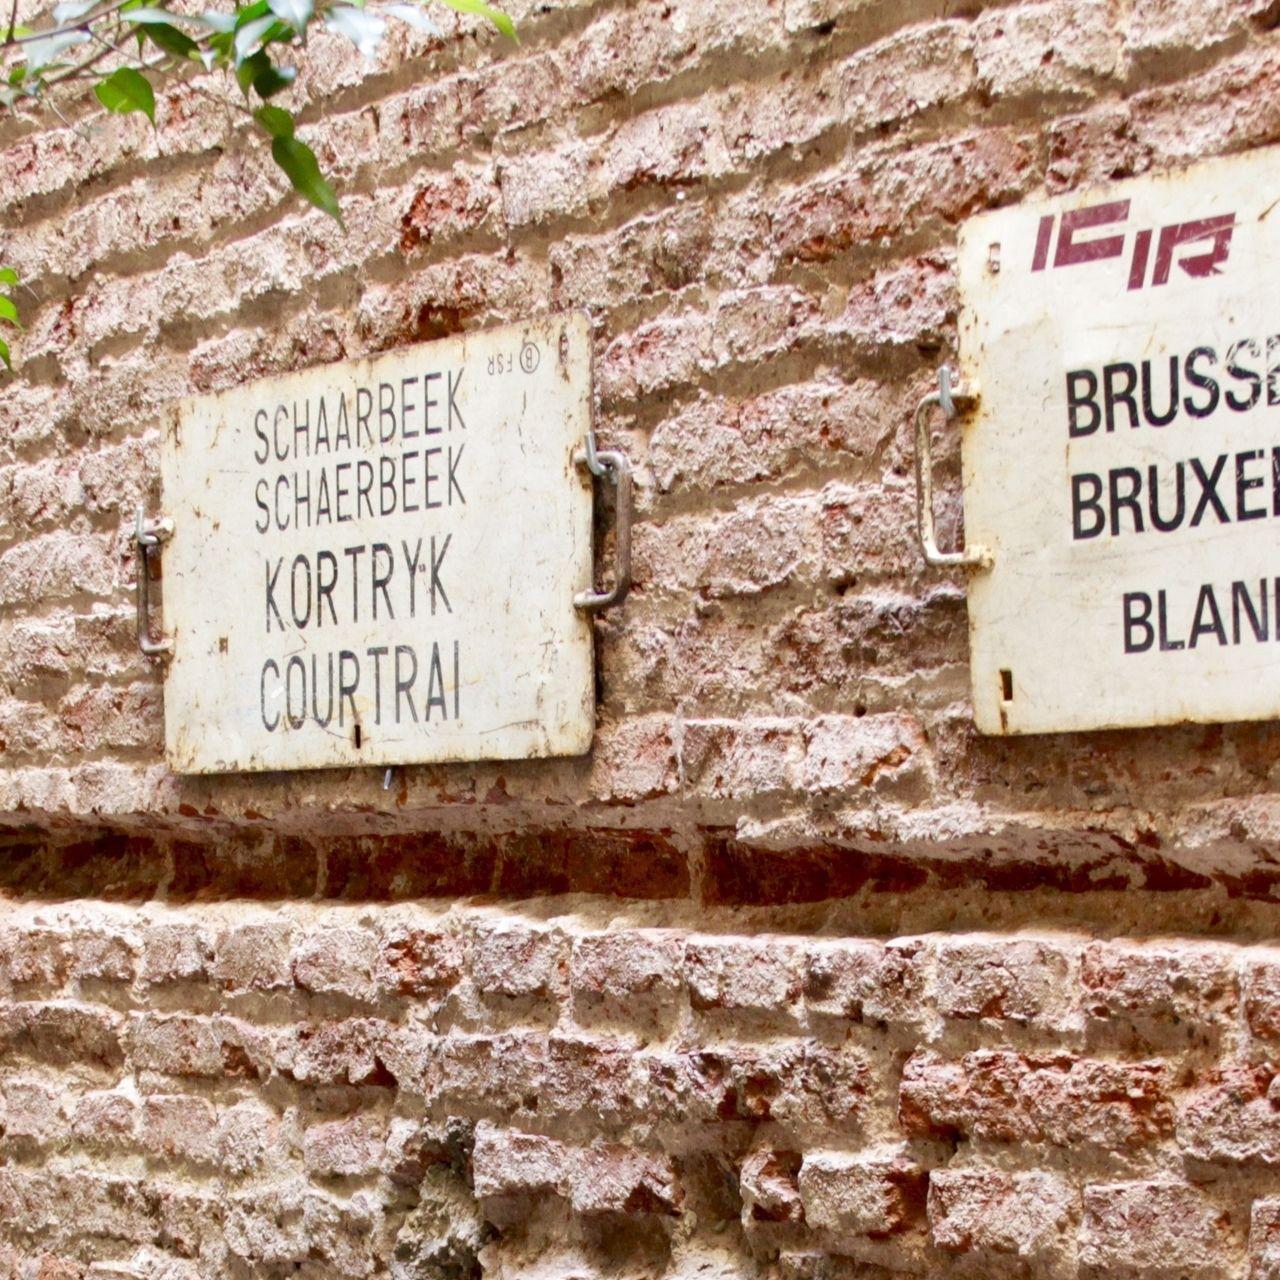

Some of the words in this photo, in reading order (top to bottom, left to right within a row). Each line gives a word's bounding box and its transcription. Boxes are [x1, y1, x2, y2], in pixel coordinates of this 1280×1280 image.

[254, 367, 466, 465] SCHAARBEEK
[255, 443, 466, 534] SCHAERBEEK
[265, 533, 454, 633] KORTRYK
[260, 639, 460, 733] COURTRAI
